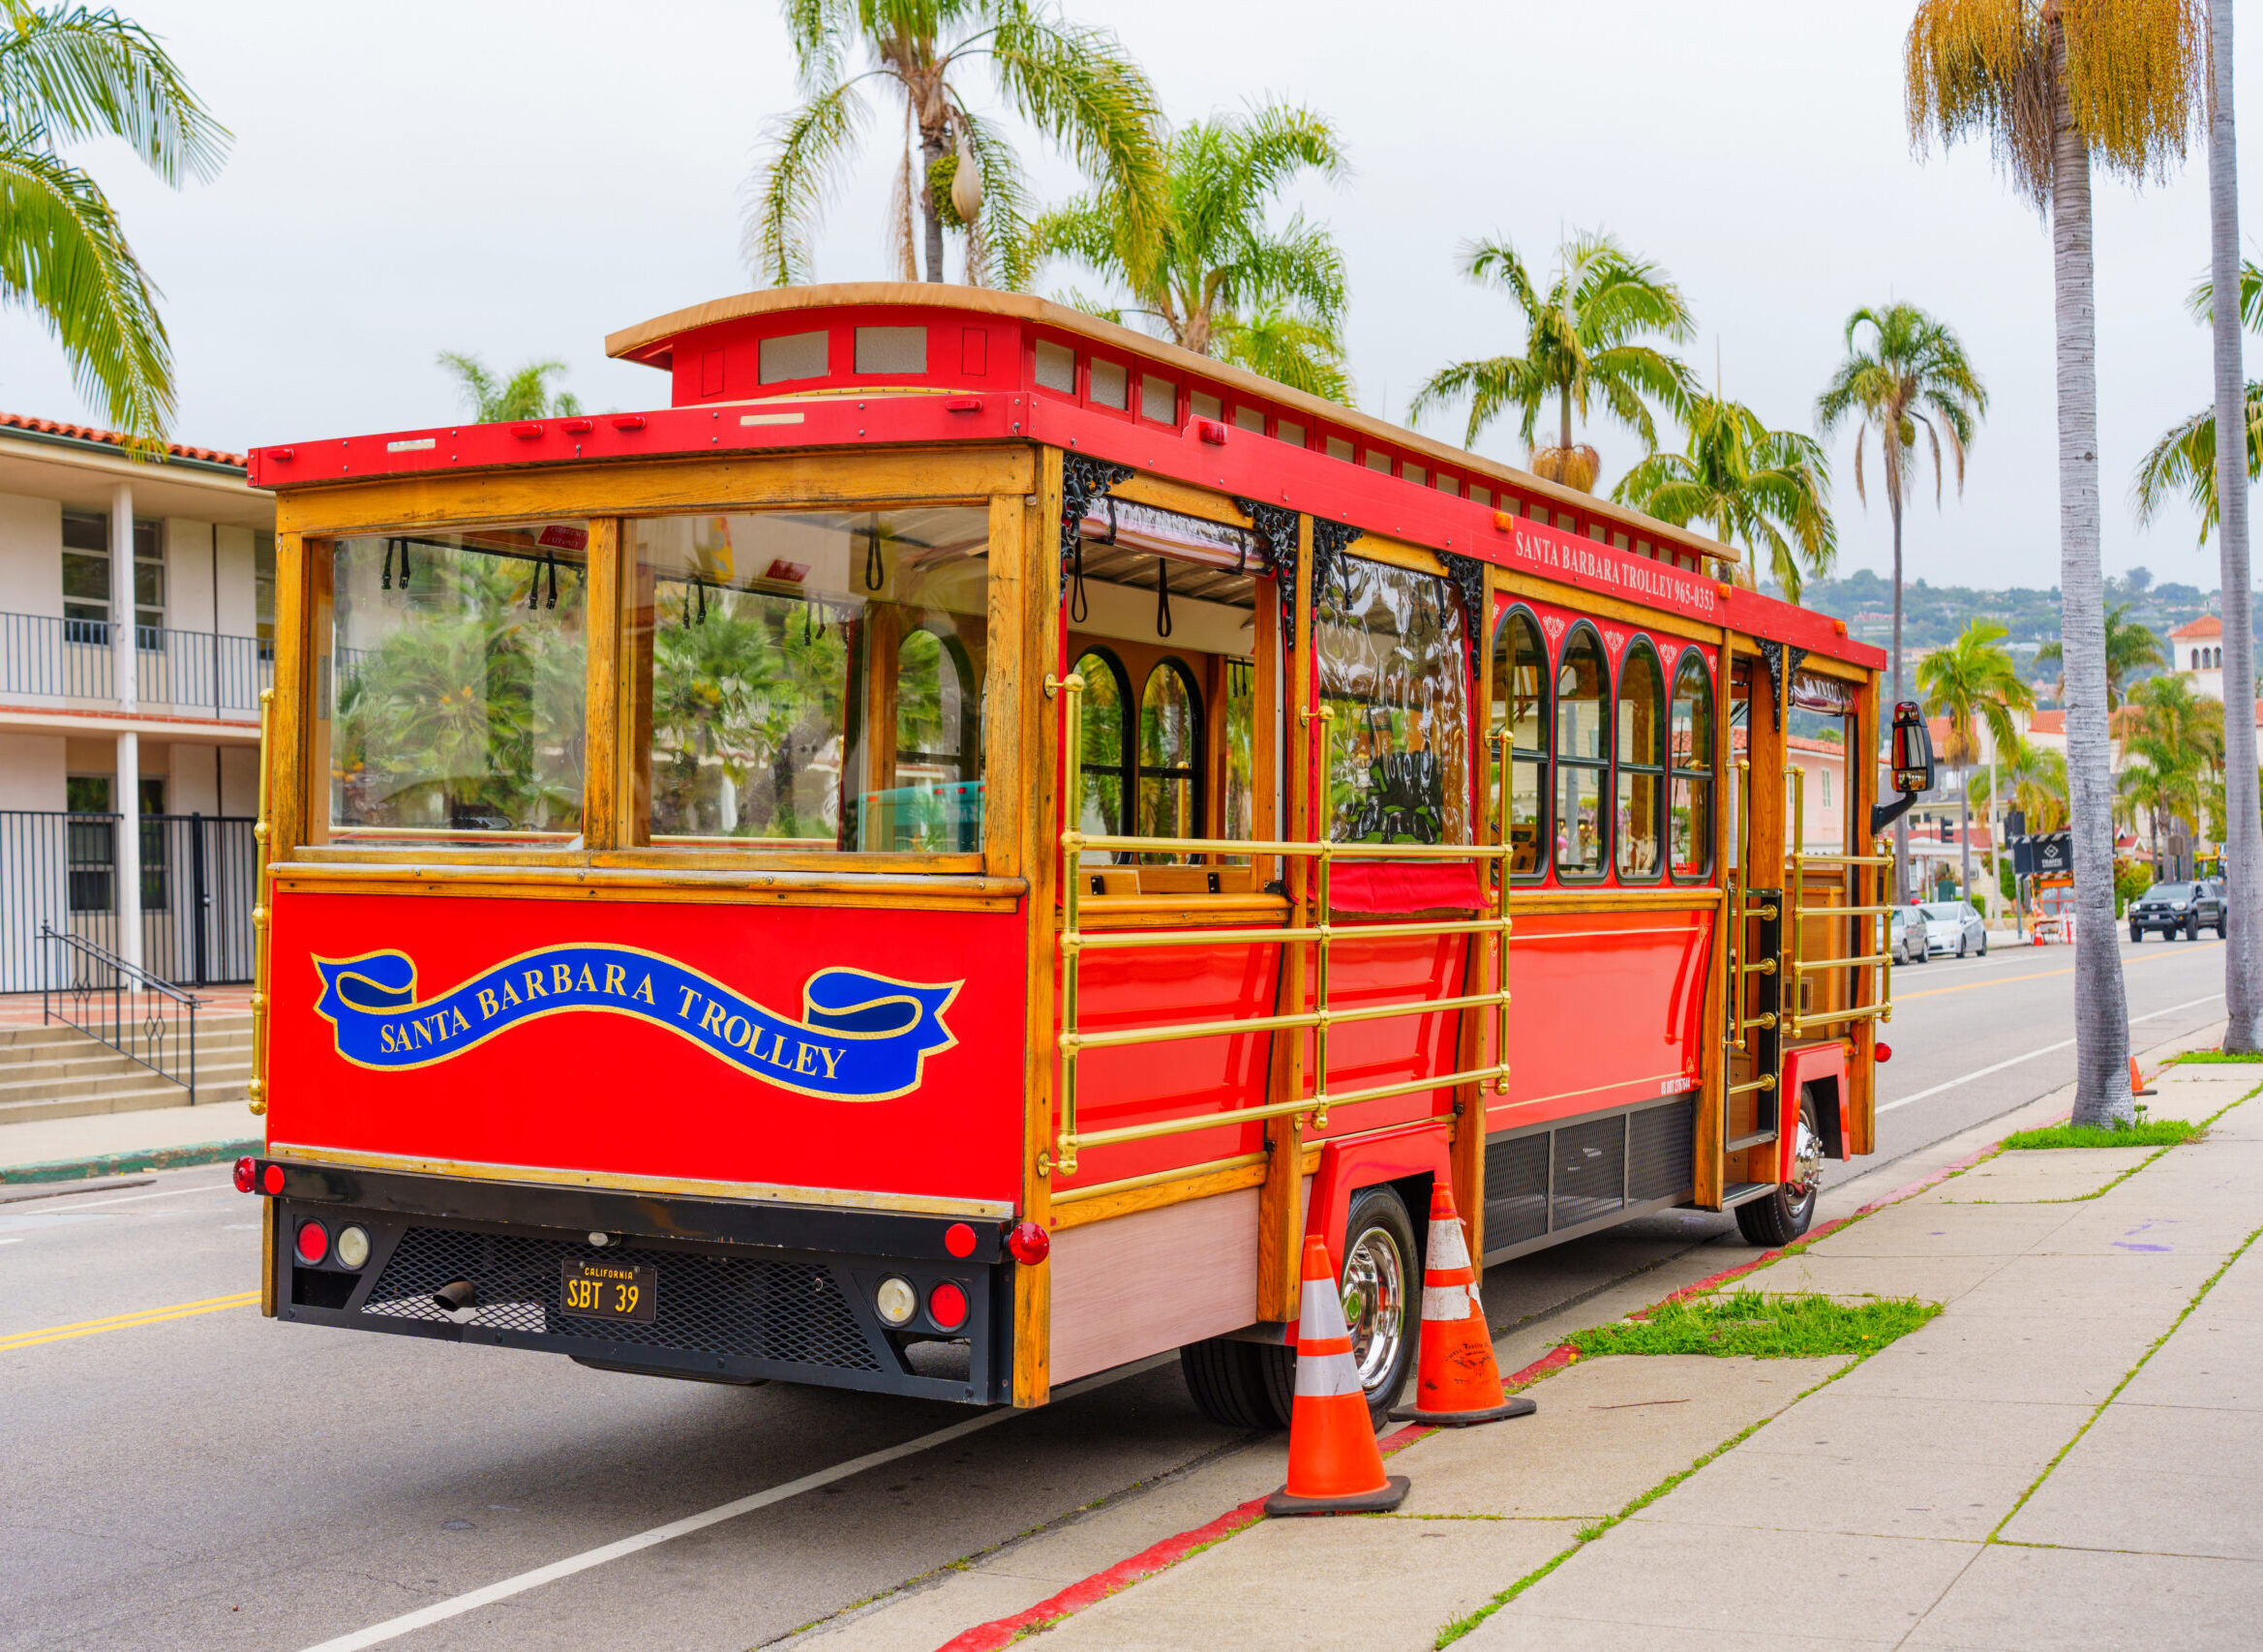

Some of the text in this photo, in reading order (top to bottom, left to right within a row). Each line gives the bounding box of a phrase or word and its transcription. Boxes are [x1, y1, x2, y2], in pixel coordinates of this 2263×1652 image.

[1516, 530, 1714, 612] SANTA BARBARA TROLLEY 965-0353
[380, 962, 847, 1079] SANTA BARBARA TROLLEY
[566, 1278, 640, 1313] SBT 39
[584, 1267, 634, 1280] CALIFORNIA
